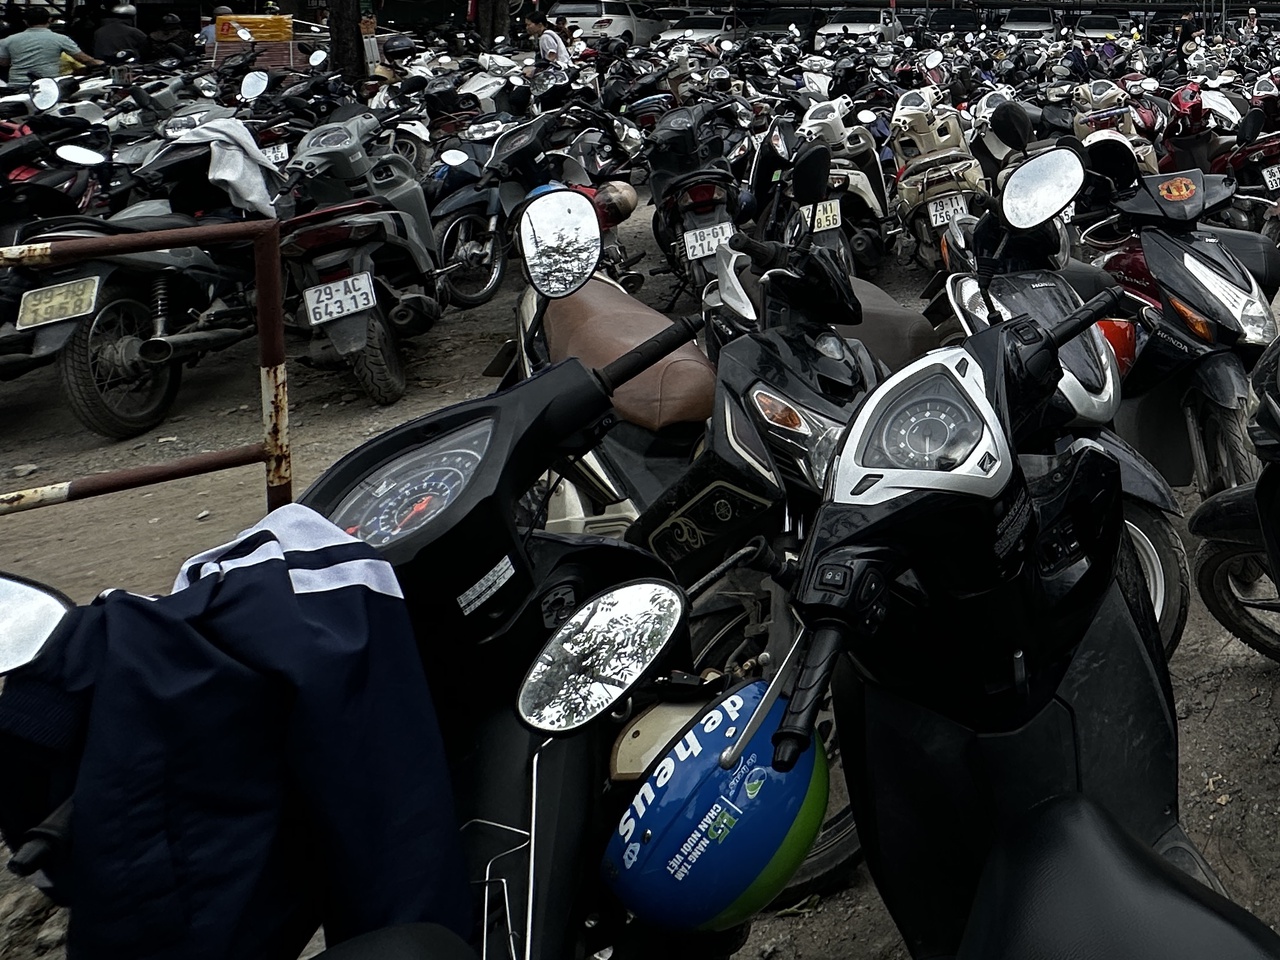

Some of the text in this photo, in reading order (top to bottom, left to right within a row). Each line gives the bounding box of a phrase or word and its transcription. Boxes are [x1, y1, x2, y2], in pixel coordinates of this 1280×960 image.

[692, 225, 725, 244] 18-G1
[314, 277, 362, 305] 29-AC
[311, 291, 371, 322] 643.13
[1157, 330, 1189, 353] HONDA
[618, 730, 703, 844] heus
